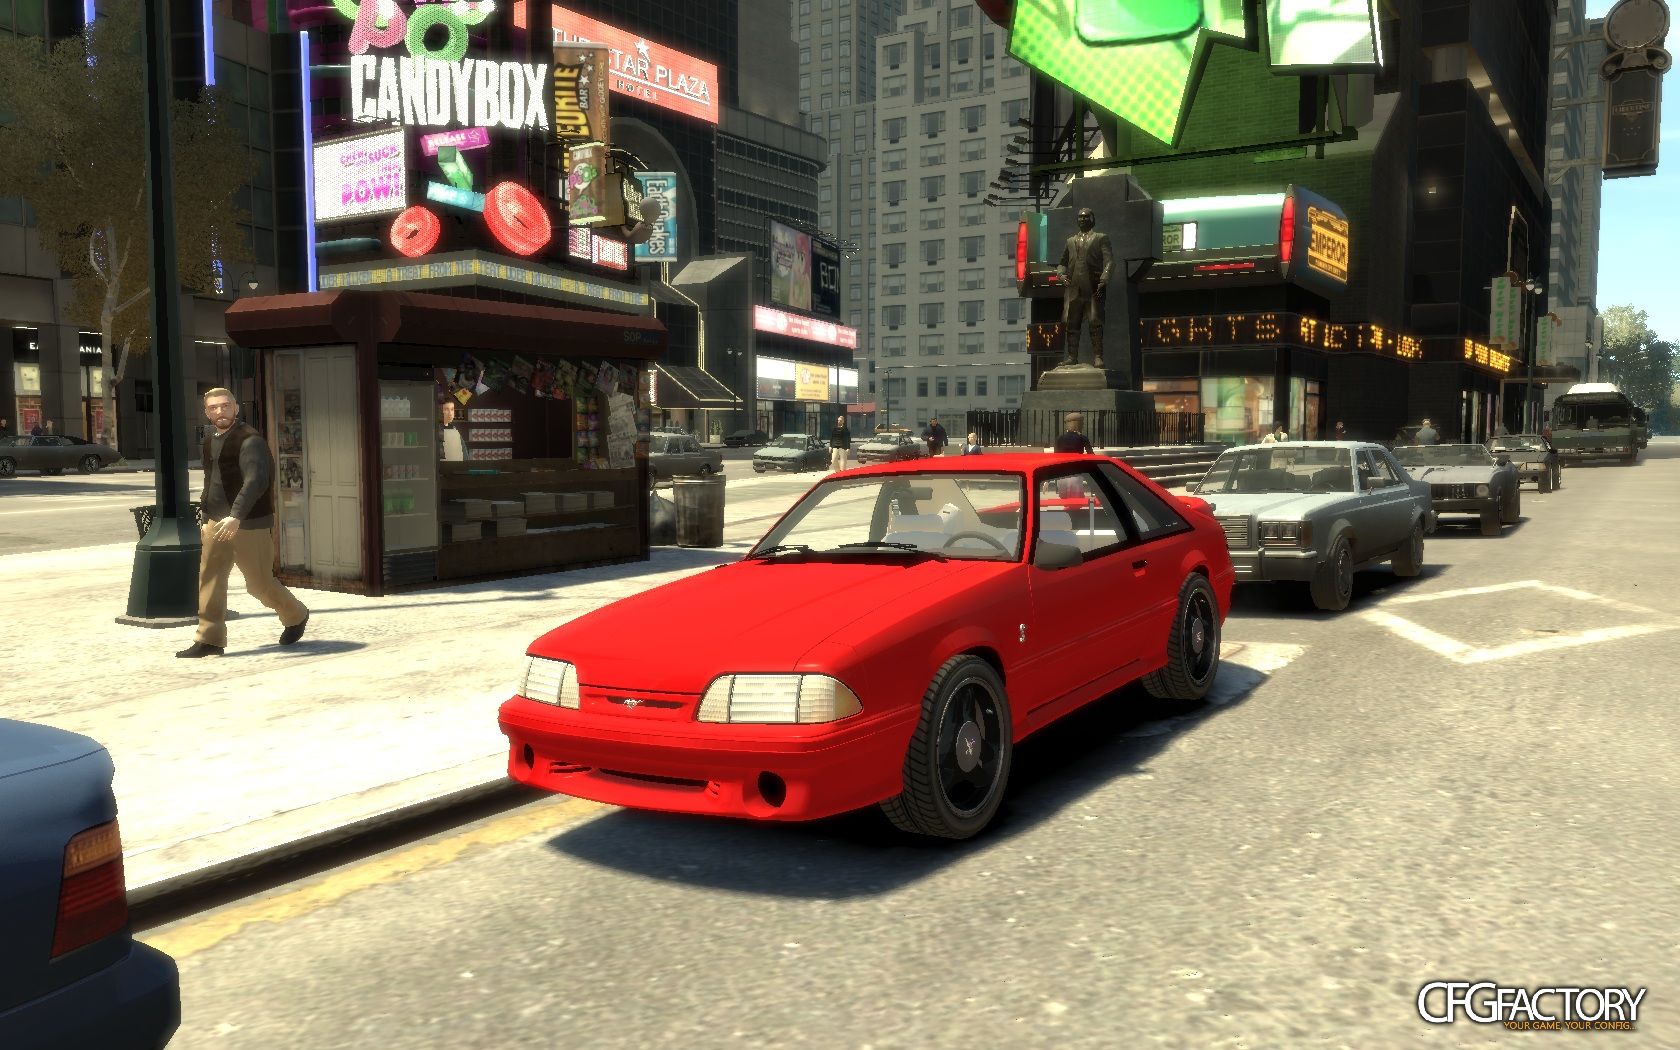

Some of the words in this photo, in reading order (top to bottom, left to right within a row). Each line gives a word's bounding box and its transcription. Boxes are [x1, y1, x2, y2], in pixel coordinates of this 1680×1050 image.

[350, 54, 548, 129] CANDYBOX
[608, 49, 649, 80] TAR
[655, 65, 710, 100] PLAZA
[616, 79, 658, 101] HOTEL
[580, 88, 589, 109] BAR
[341, 172, 400, 207] POW!
[1311, 229, 1347, 265] EMPEROR
